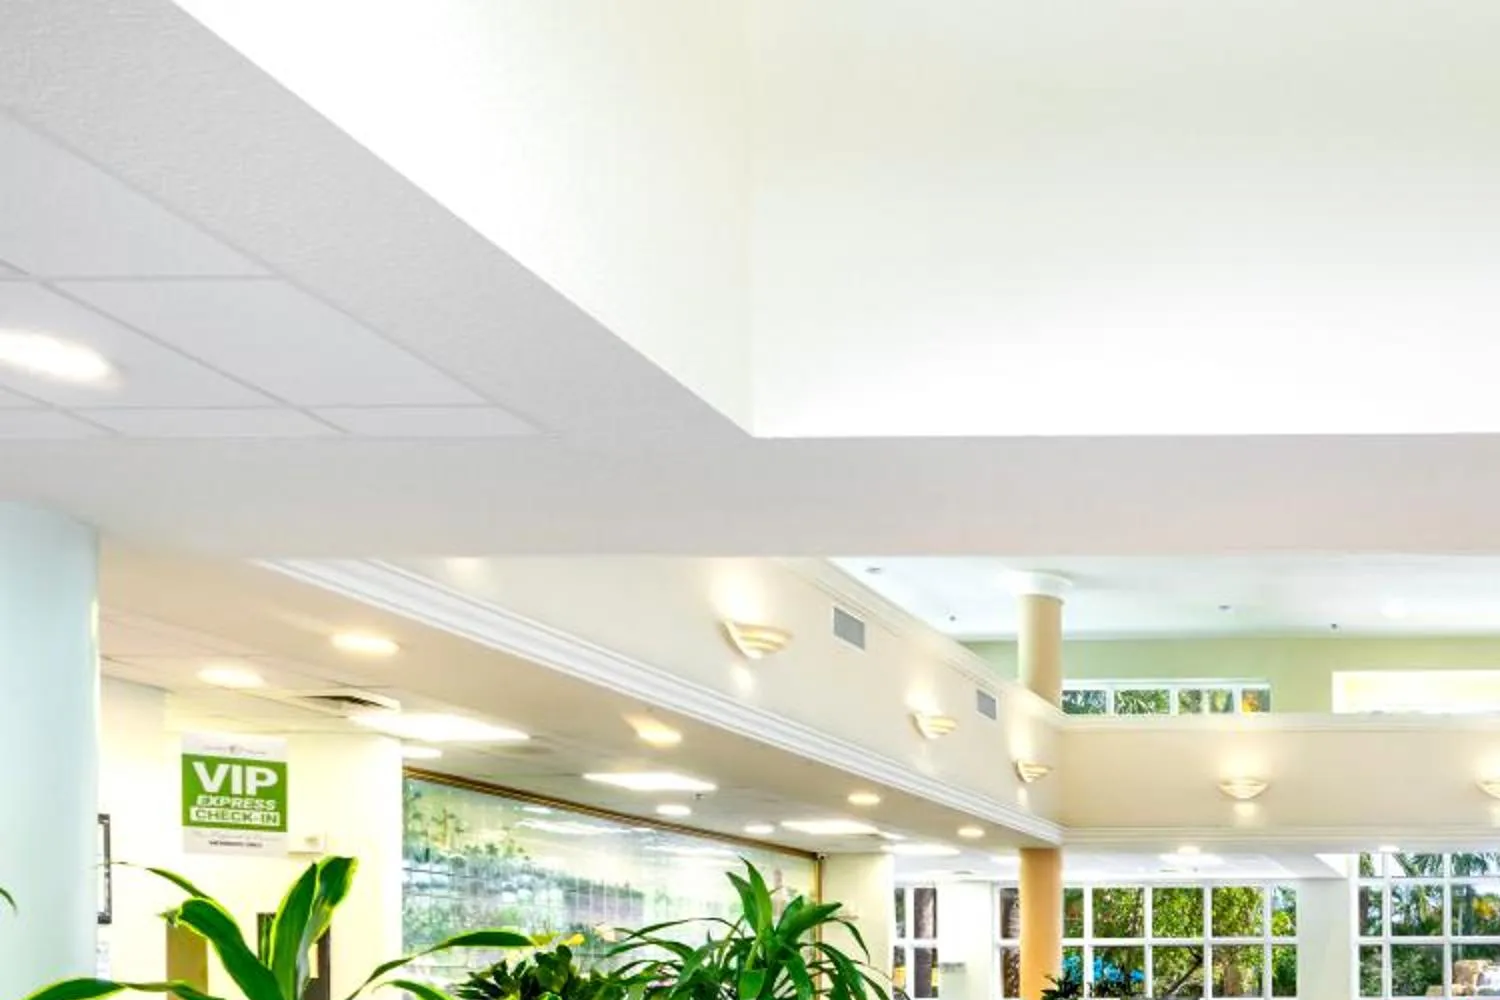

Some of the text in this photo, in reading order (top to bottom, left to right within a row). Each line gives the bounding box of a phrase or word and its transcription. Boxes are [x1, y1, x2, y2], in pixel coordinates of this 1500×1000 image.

[192, 761, 278, 796] VIP
[196, 795, 276, 810] EXPRESS
[195, 809, 277, 824] CHECK-IN
